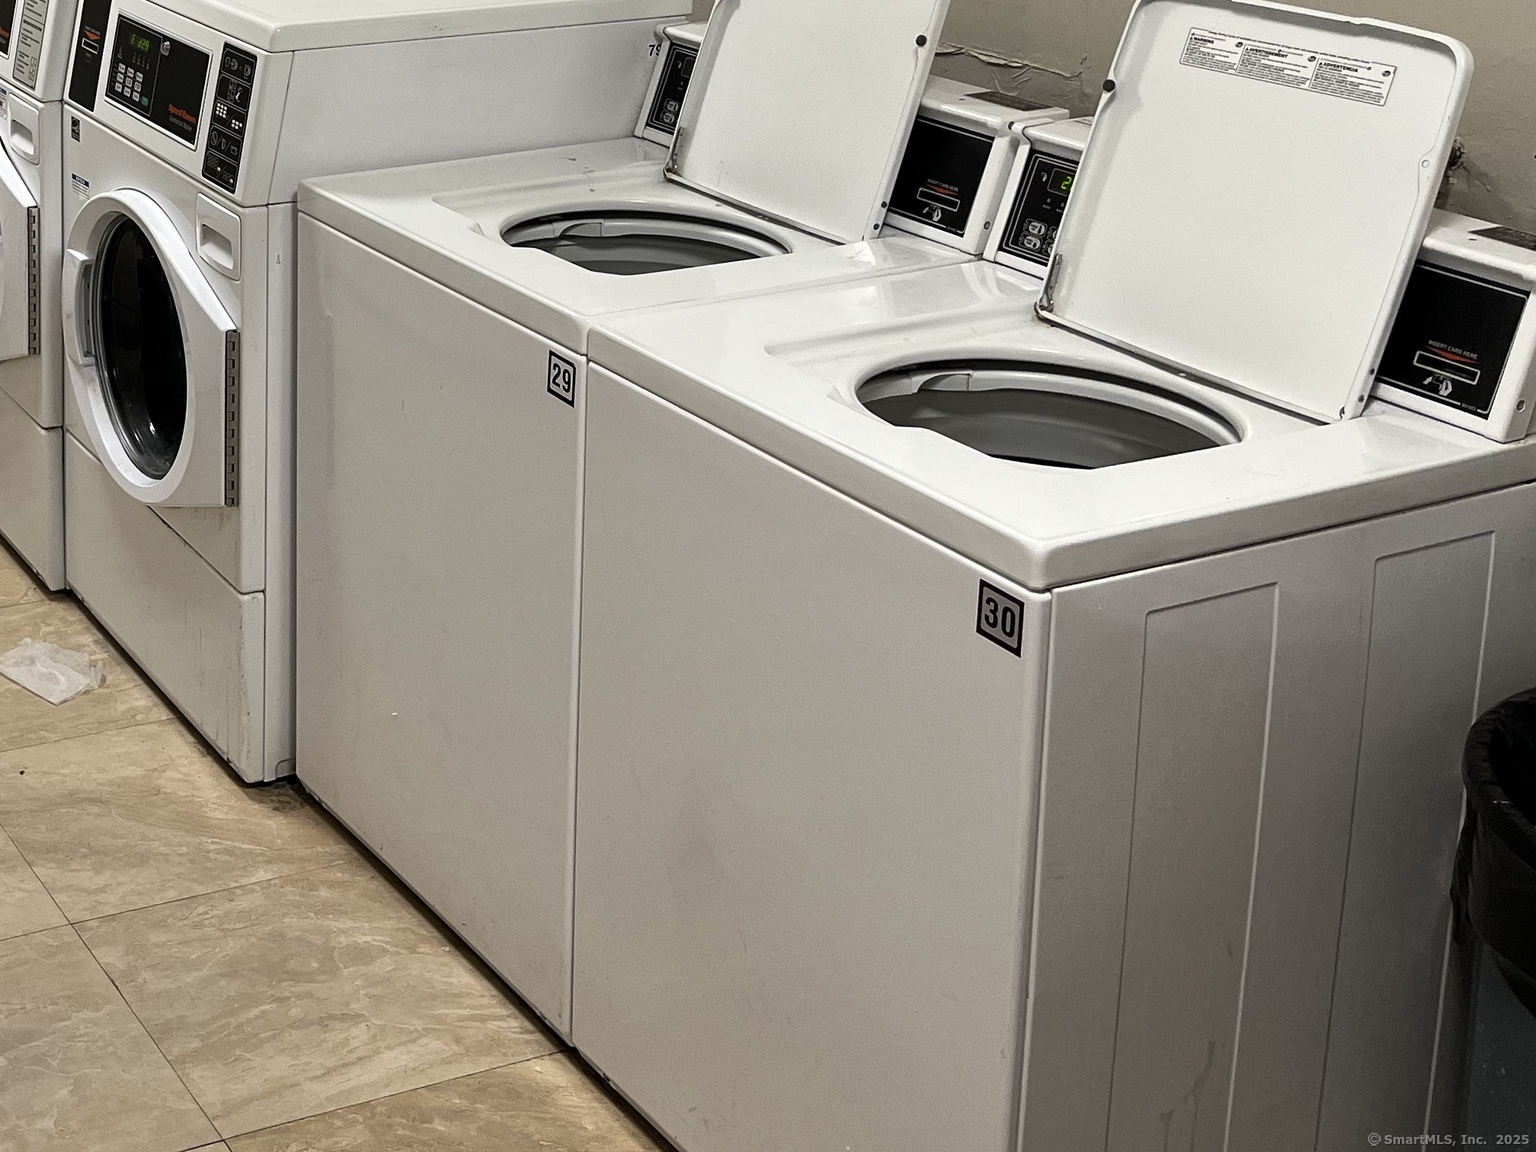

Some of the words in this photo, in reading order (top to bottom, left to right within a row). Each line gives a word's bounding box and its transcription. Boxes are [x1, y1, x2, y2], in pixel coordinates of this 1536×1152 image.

[1429, 340, 1447, 348] INSERT
[1447, 346, 1462, 354] CARD
[1463, 351, 1478, 360] HERE
[552, 362, 571, 393] 29
[984, 596, 1016, 638] 30
